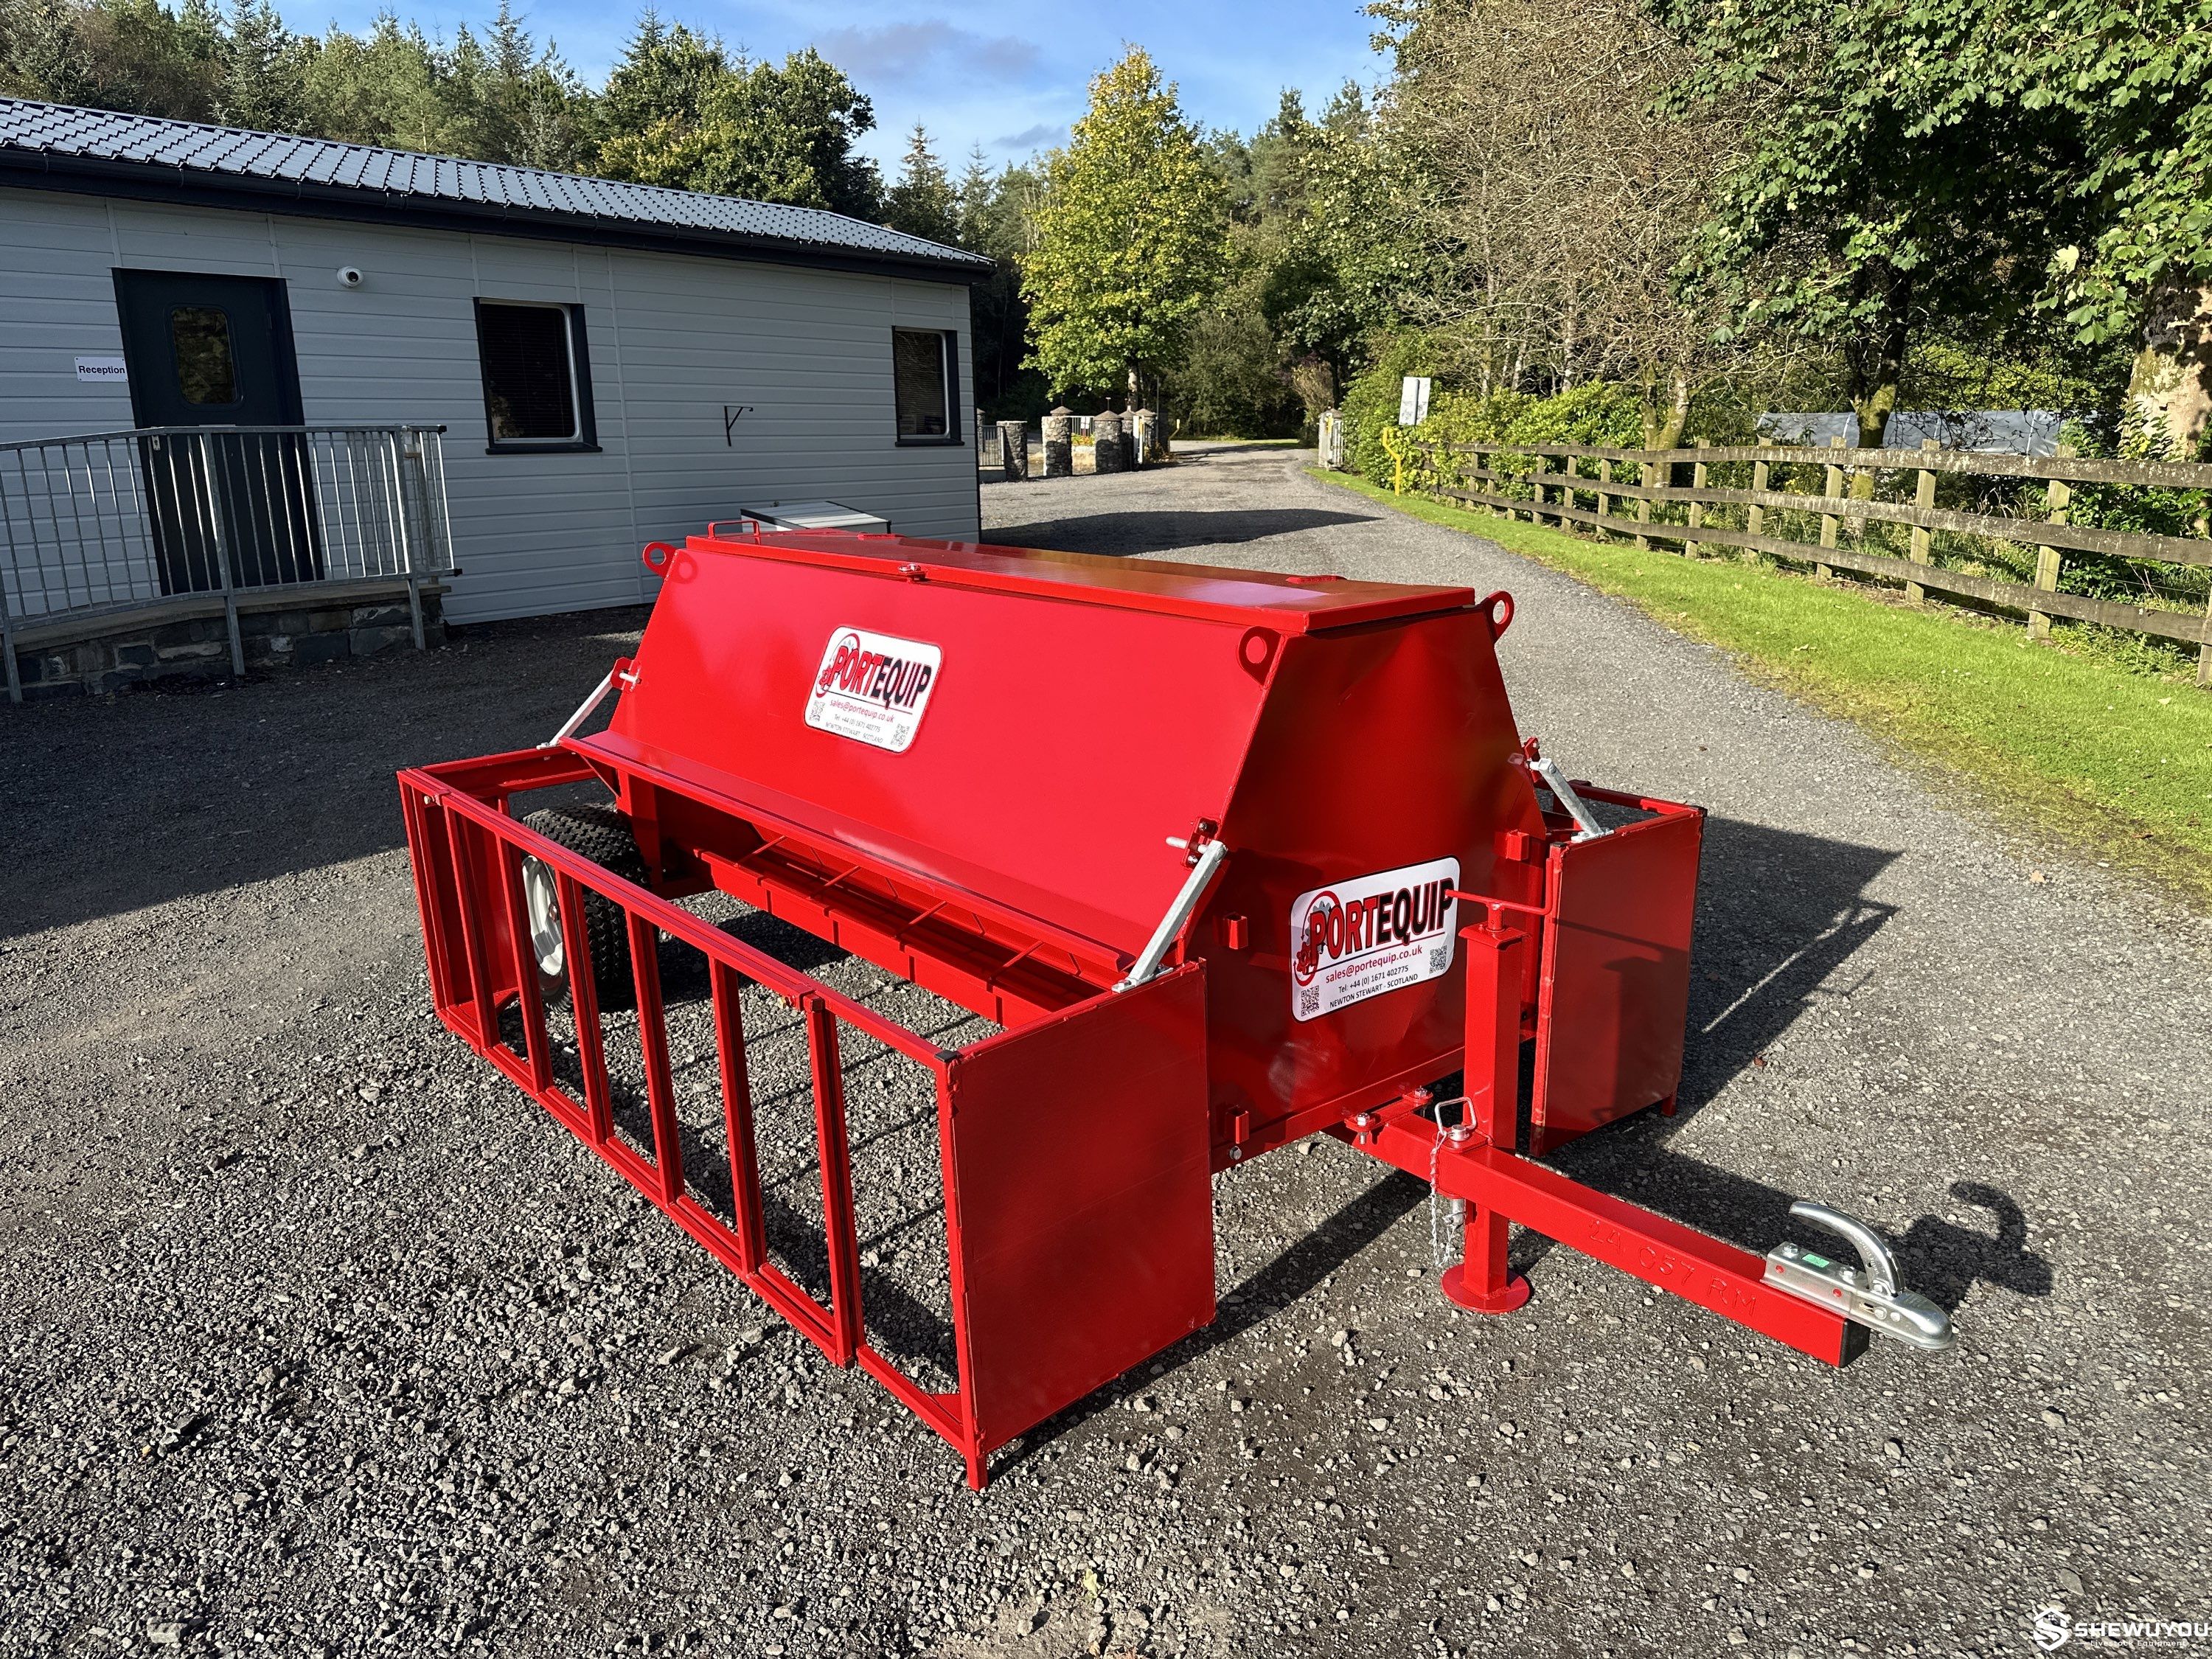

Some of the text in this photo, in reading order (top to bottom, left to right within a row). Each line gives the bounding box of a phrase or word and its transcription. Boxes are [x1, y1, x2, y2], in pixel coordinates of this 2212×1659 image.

[78, 365, 125, 375] Reception
[829, 645, 932, 710] PORTEQUIP
[830, 699, 894, 723] sales@portequip.co.uk
[1310, 877, 1454, 966] PORTEQUIP
[1326, 945, 1422, 983] sales@portequip.co.uk
[1338, 965, 1408, 993] Tel: +44 (0) 1671 402775
[1329, 993, 1354, 1008] NEWTON
[1357, 984, 1382, 998] STEWART
[1387, 973, 1418, 988] SCOTLAND
[1706, 1275, 1756, 1316] RM
